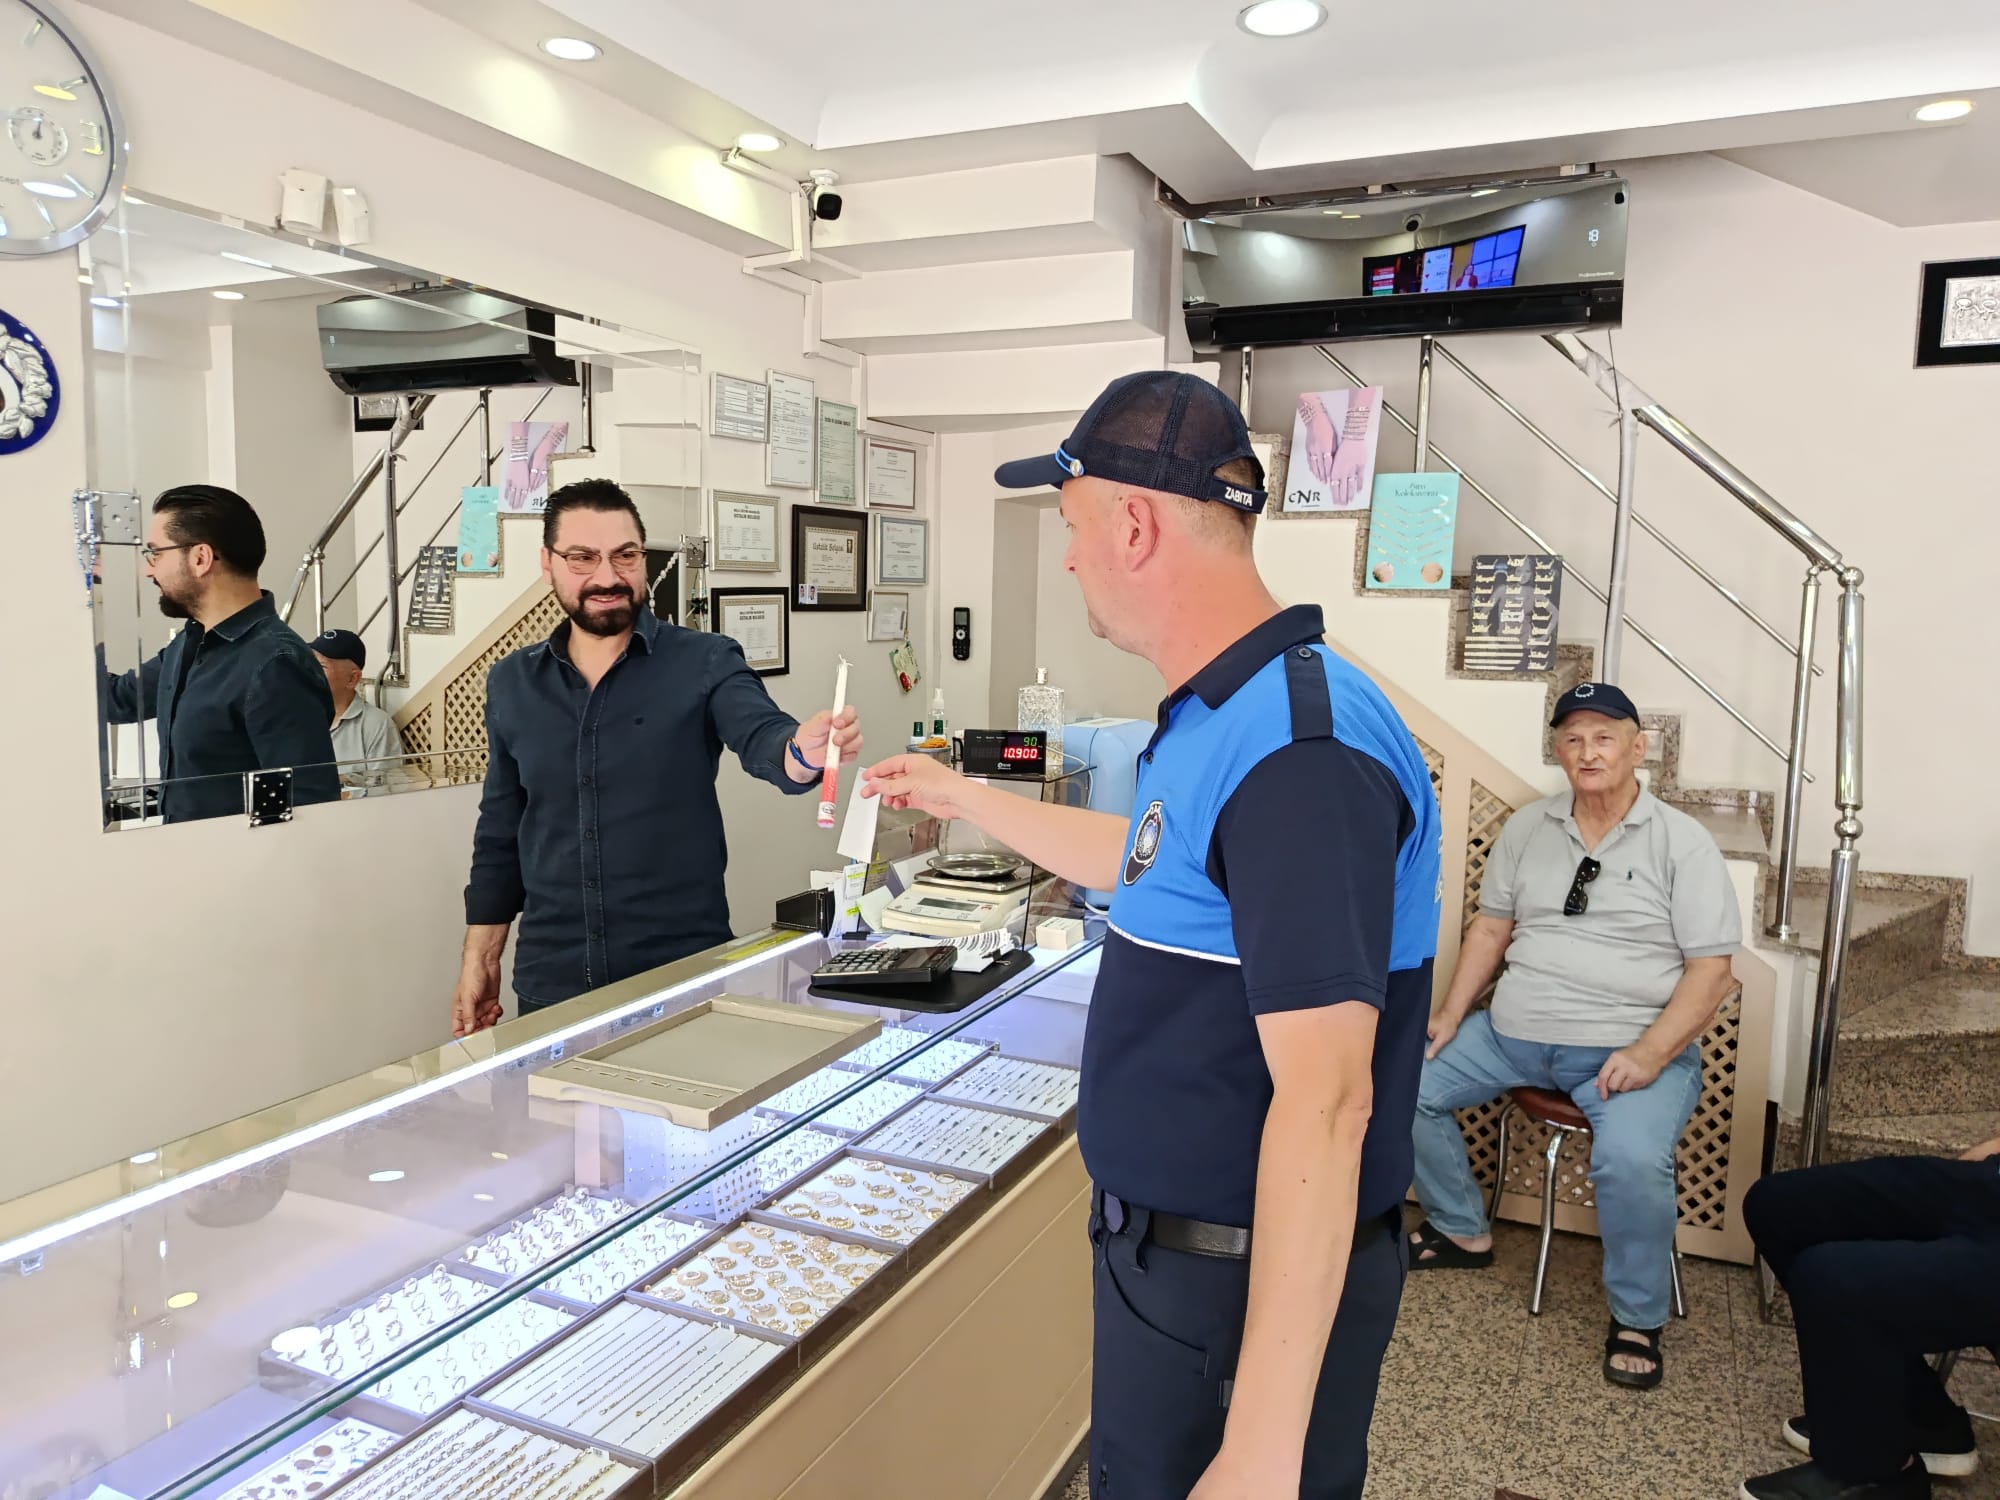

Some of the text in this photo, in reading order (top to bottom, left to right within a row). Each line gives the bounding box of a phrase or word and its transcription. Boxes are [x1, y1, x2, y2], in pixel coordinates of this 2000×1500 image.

[1224, 486, 1253, 507] ZABITA
[1288, 489, 1321, 505] CNR
[1023, 736, 1038, 747] 90
